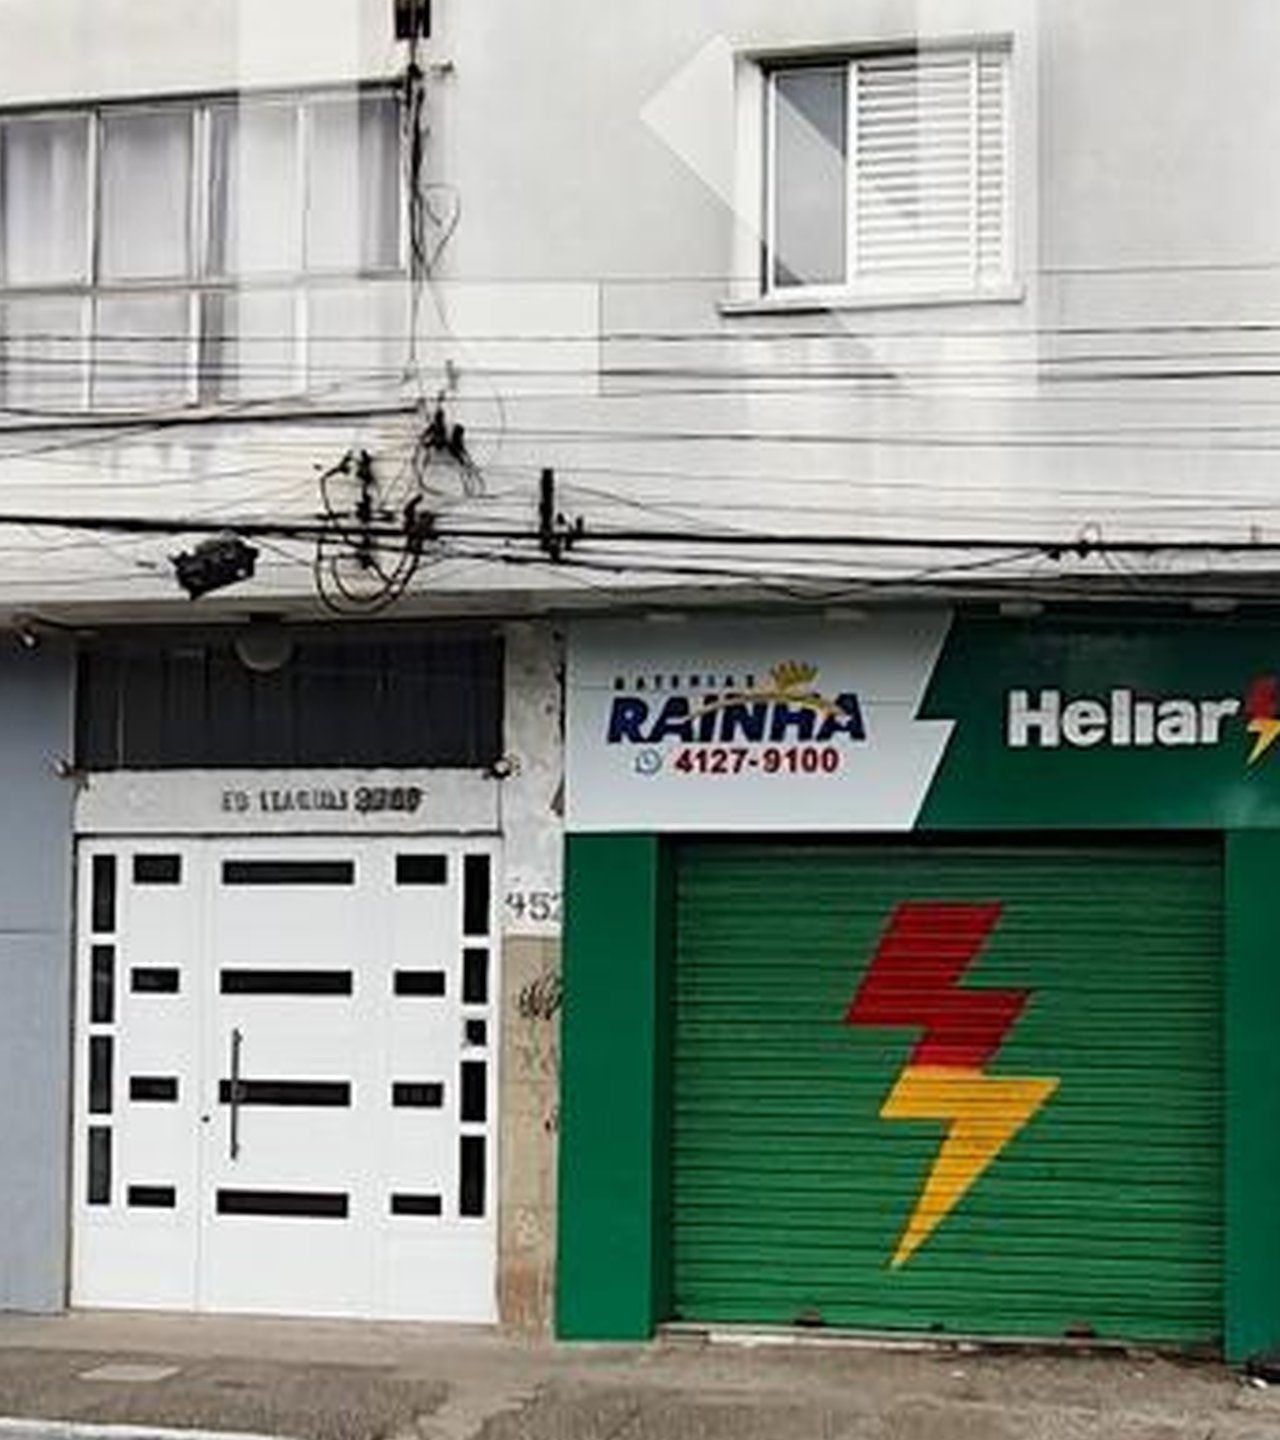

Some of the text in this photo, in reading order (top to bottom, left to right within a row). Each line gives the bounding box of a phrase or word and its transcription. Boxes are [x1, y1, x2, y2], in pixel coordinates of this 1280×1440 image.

[607, 693, 867, 744] RAINHA
[1006, 689, 1241, 748] Heliar
[674, 747, 841, 774] 4127-9100
